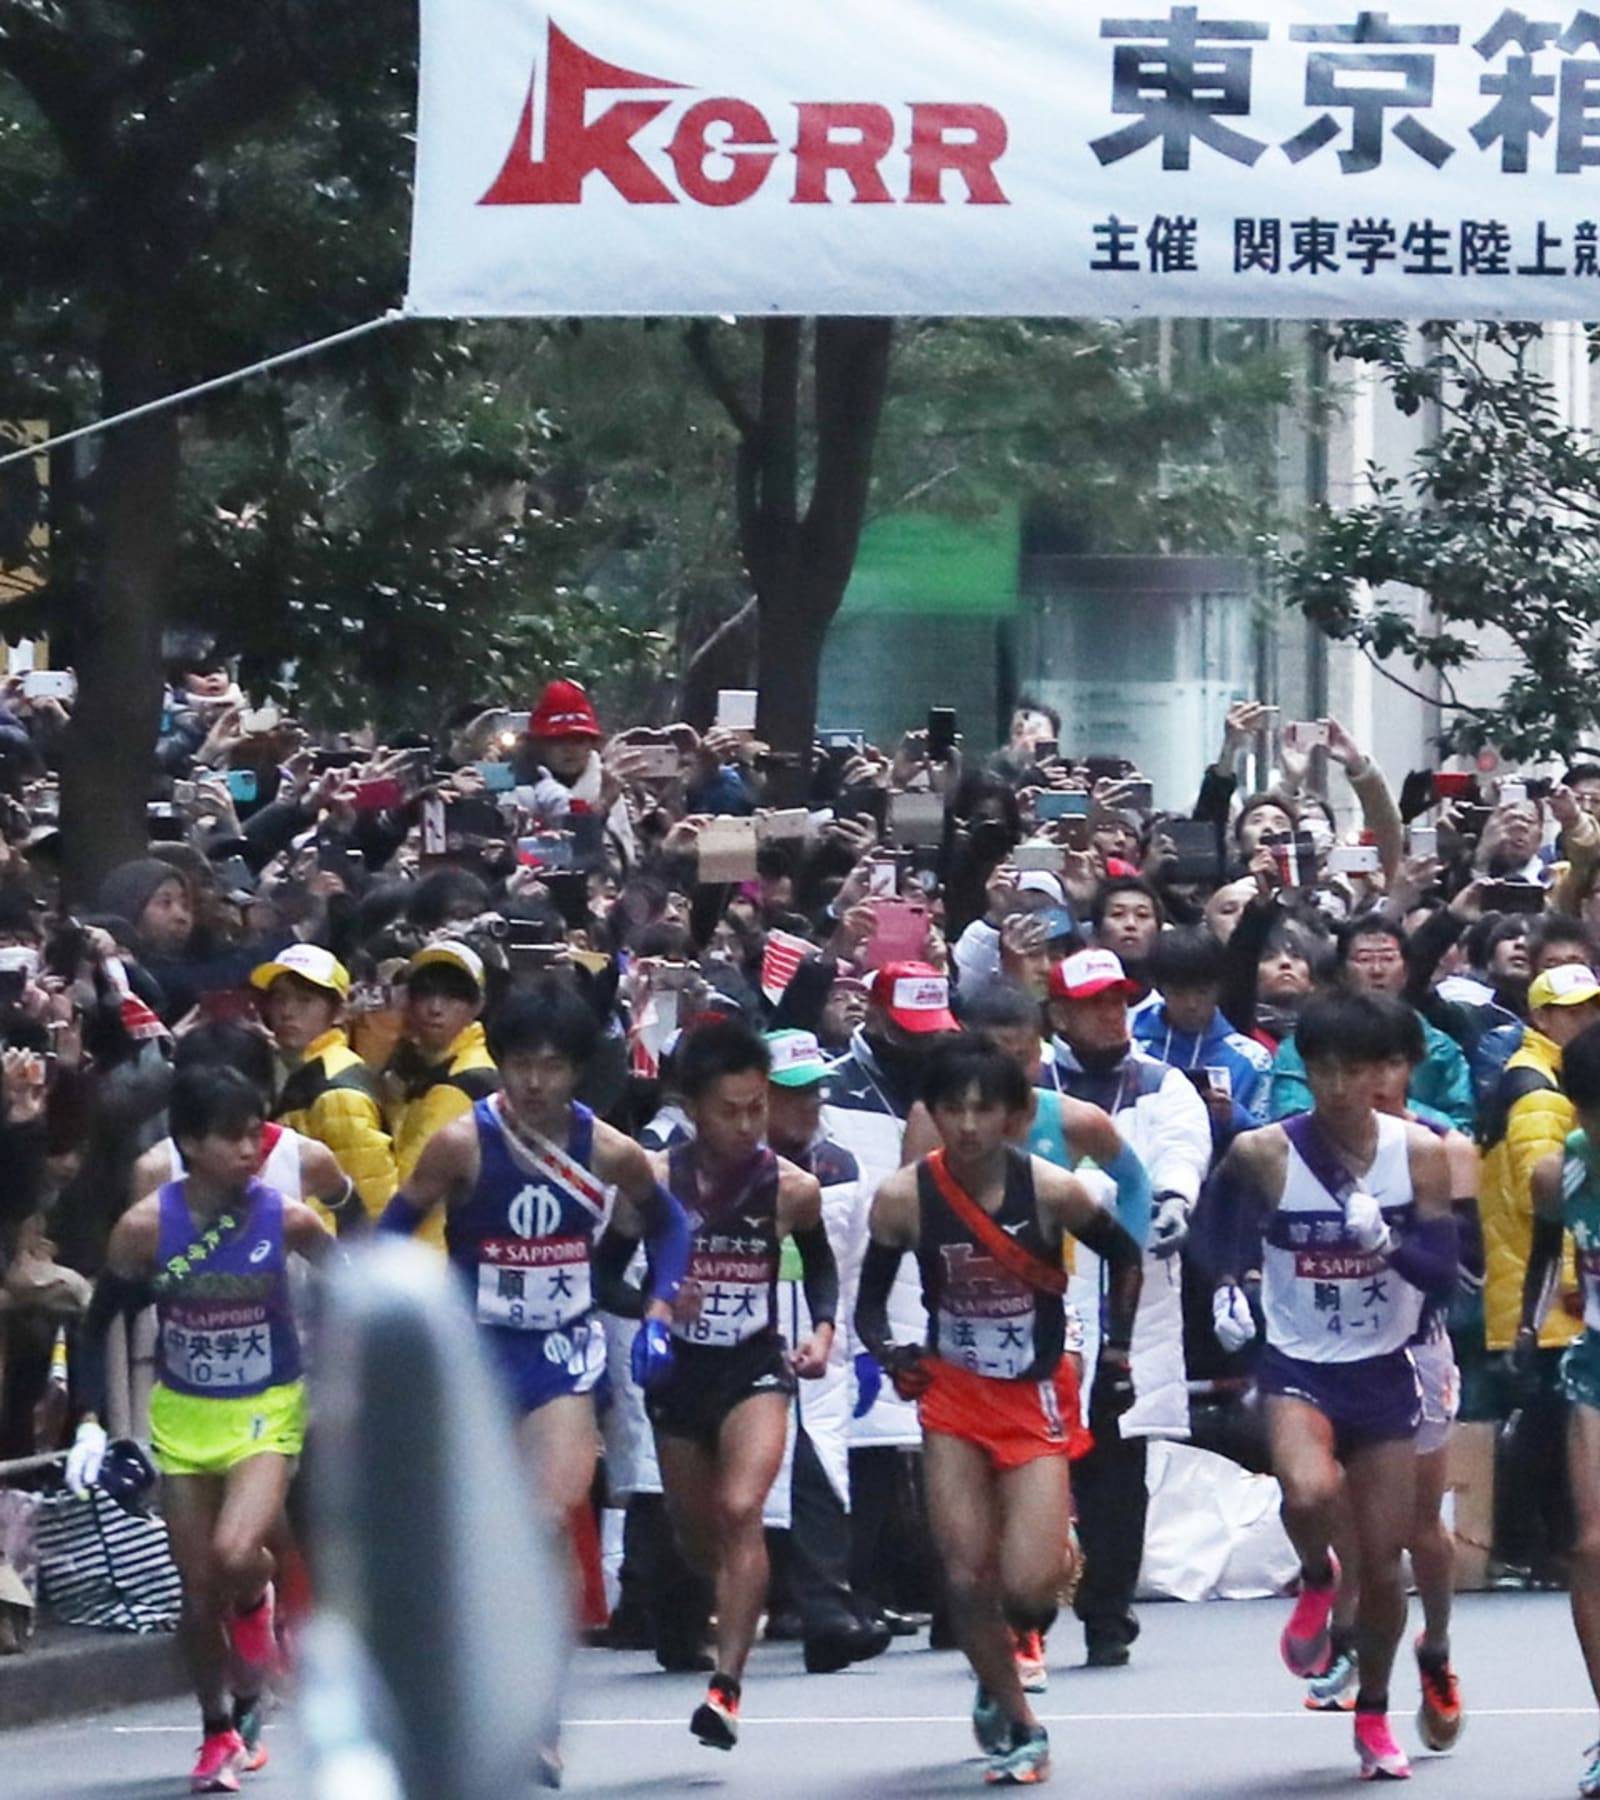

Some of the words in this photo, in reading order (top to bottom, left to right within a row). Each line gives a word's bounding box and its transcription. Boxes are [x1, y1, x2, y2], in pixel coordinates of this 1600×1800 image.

[1090, 215, 1198, 274] 主催
[506, 1241, 588, 1262] SAPPORO
[1326, 1313, 1380, 1335] 4-1
